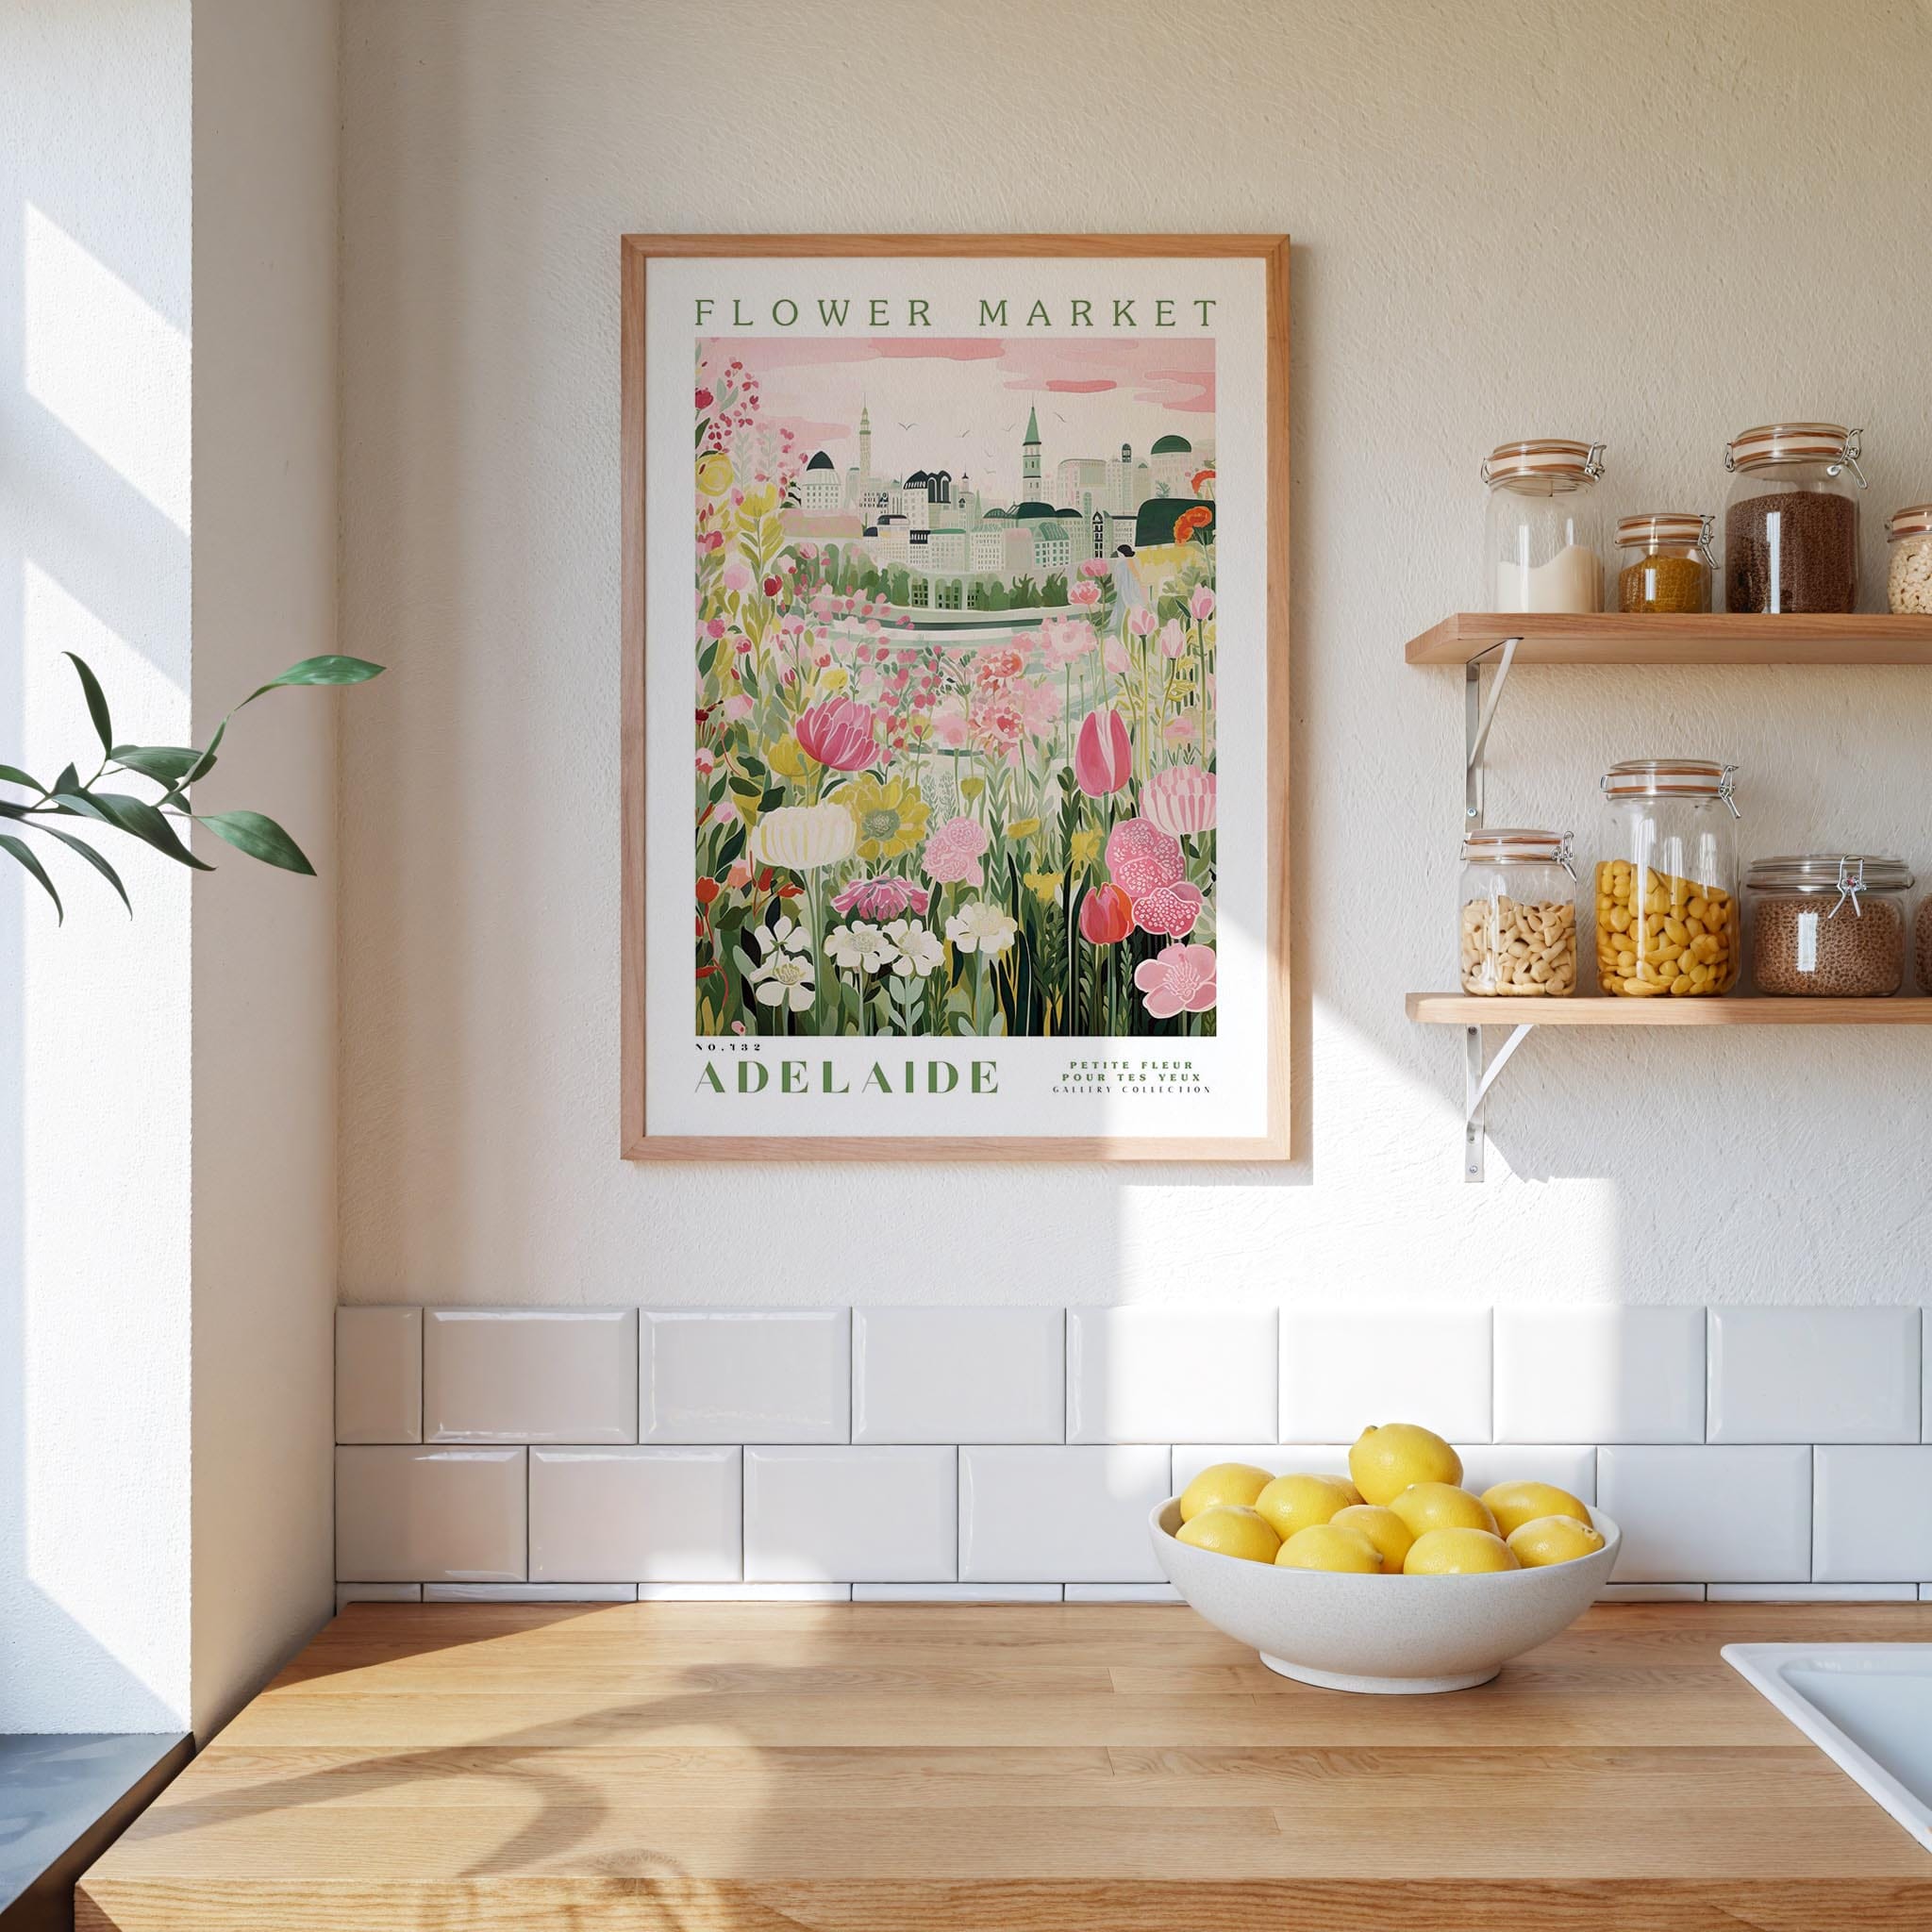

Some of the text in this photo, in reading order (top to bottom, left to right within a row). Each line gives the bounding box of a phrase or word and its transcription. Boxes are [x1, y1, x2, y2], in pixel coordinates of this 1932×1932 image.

[694, 298, 1218, 327] FLOWER MARKET
[1069, 1060, 1193, 1070] PETITE FLEUR
[694, 1060, 1000, 1093] ADELAIDE
[1061, 1073, 1201, 1082] POUR TES YEUX
[1052, 1085, 1211, 1094] GALLERY COLLECTION
